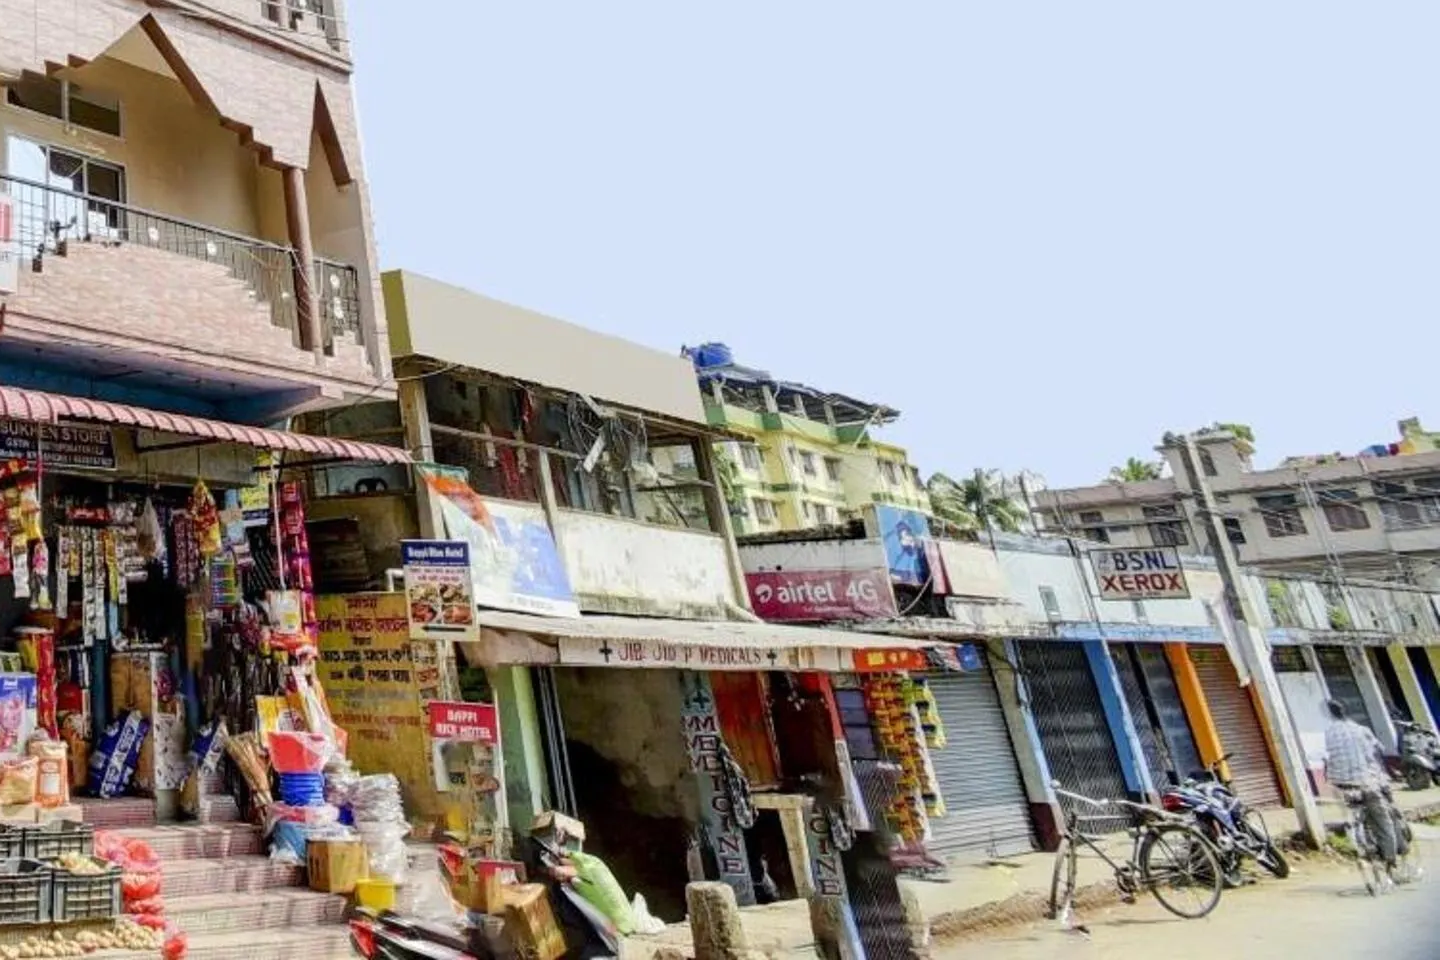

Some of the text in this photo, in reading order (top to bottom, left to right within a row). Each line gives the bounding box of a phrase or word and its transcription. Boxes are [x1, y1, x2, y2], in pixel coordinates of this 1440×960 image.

[1111, 550, 1177, 571] BSNL
[777, 579, 878, 604] airtel 4G
[1101, 573, 1183, 592] XEROX
[699, 646, 761, 665] MEDICALS
